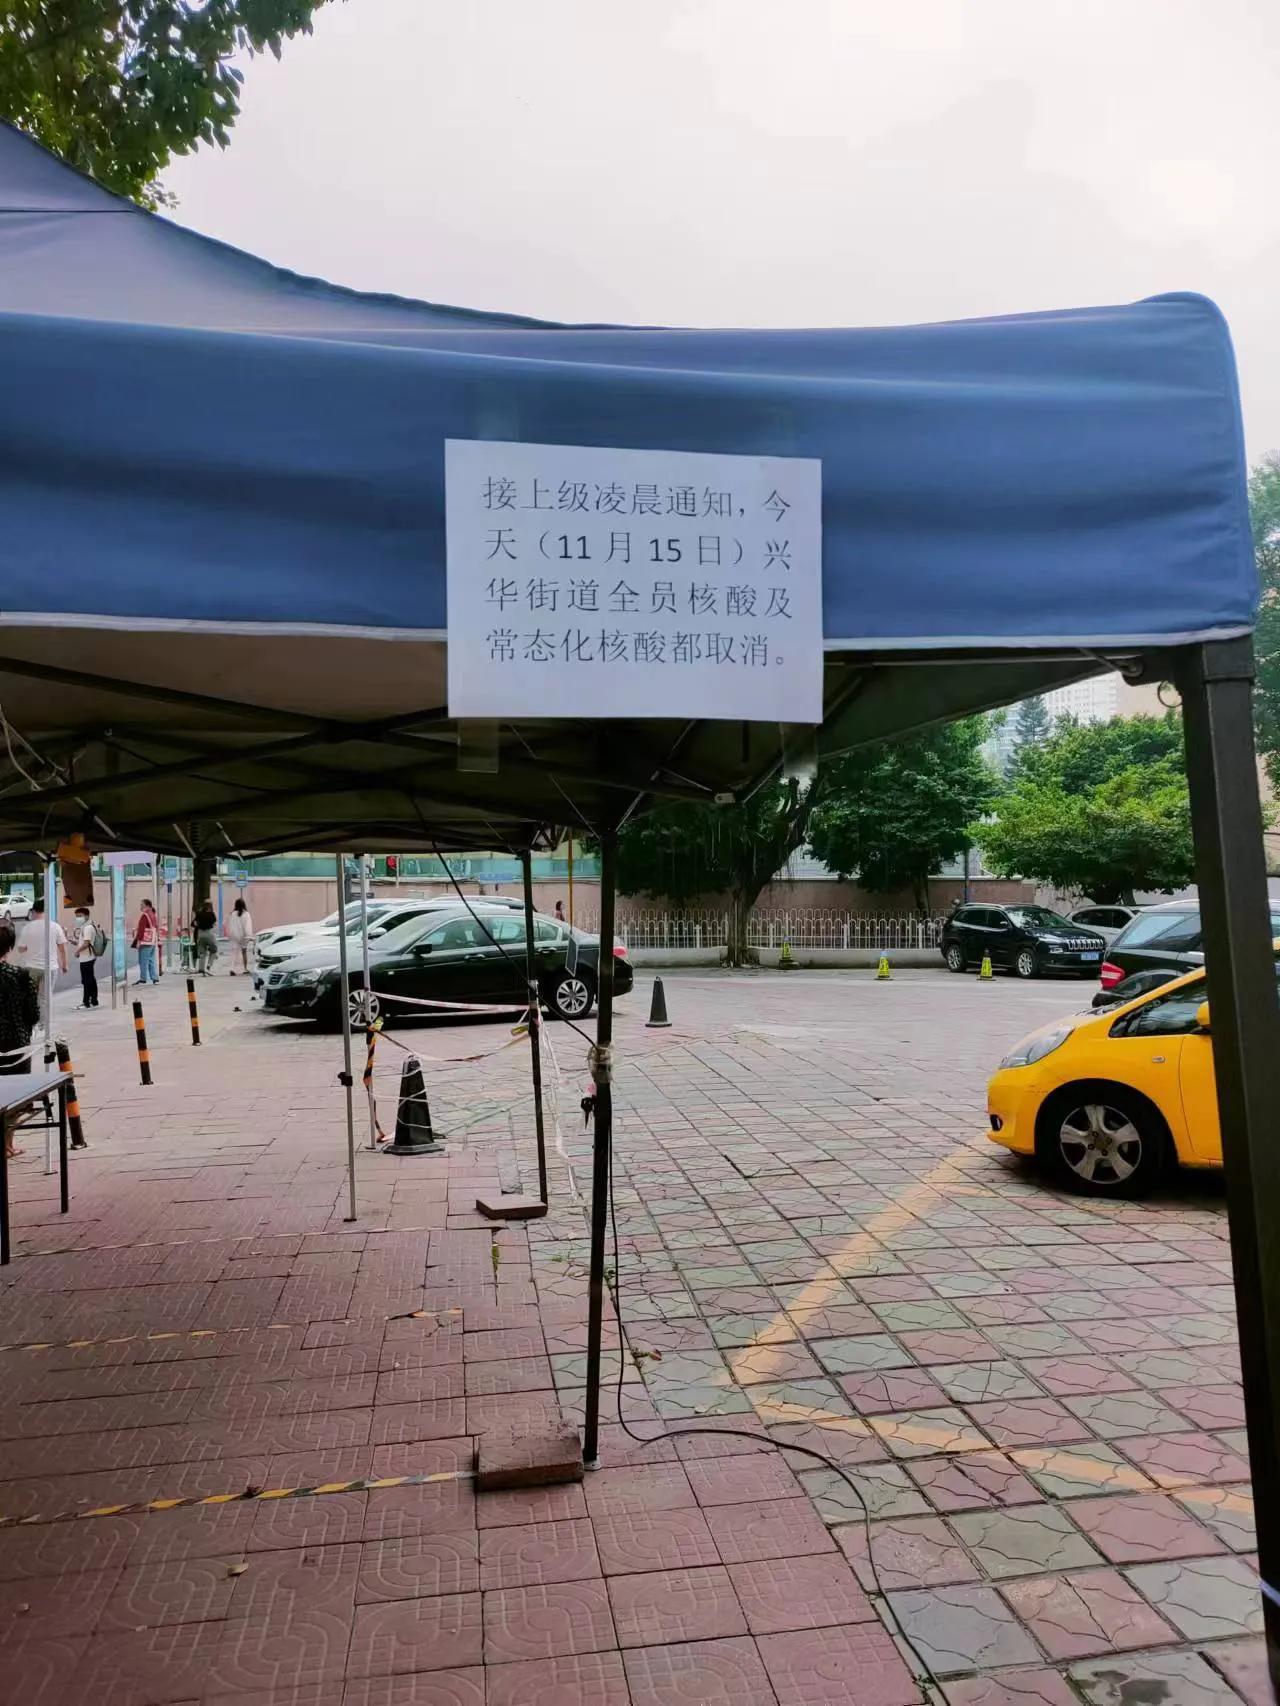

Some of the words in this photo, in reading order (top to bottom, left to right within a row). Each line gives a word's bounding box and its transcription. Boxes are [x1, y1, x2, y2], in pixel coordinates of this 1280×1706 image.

[484, 577, 793, 619] 华街道全员核酸及
[485, 627, 784, 667] 常态化核酸都取消。
